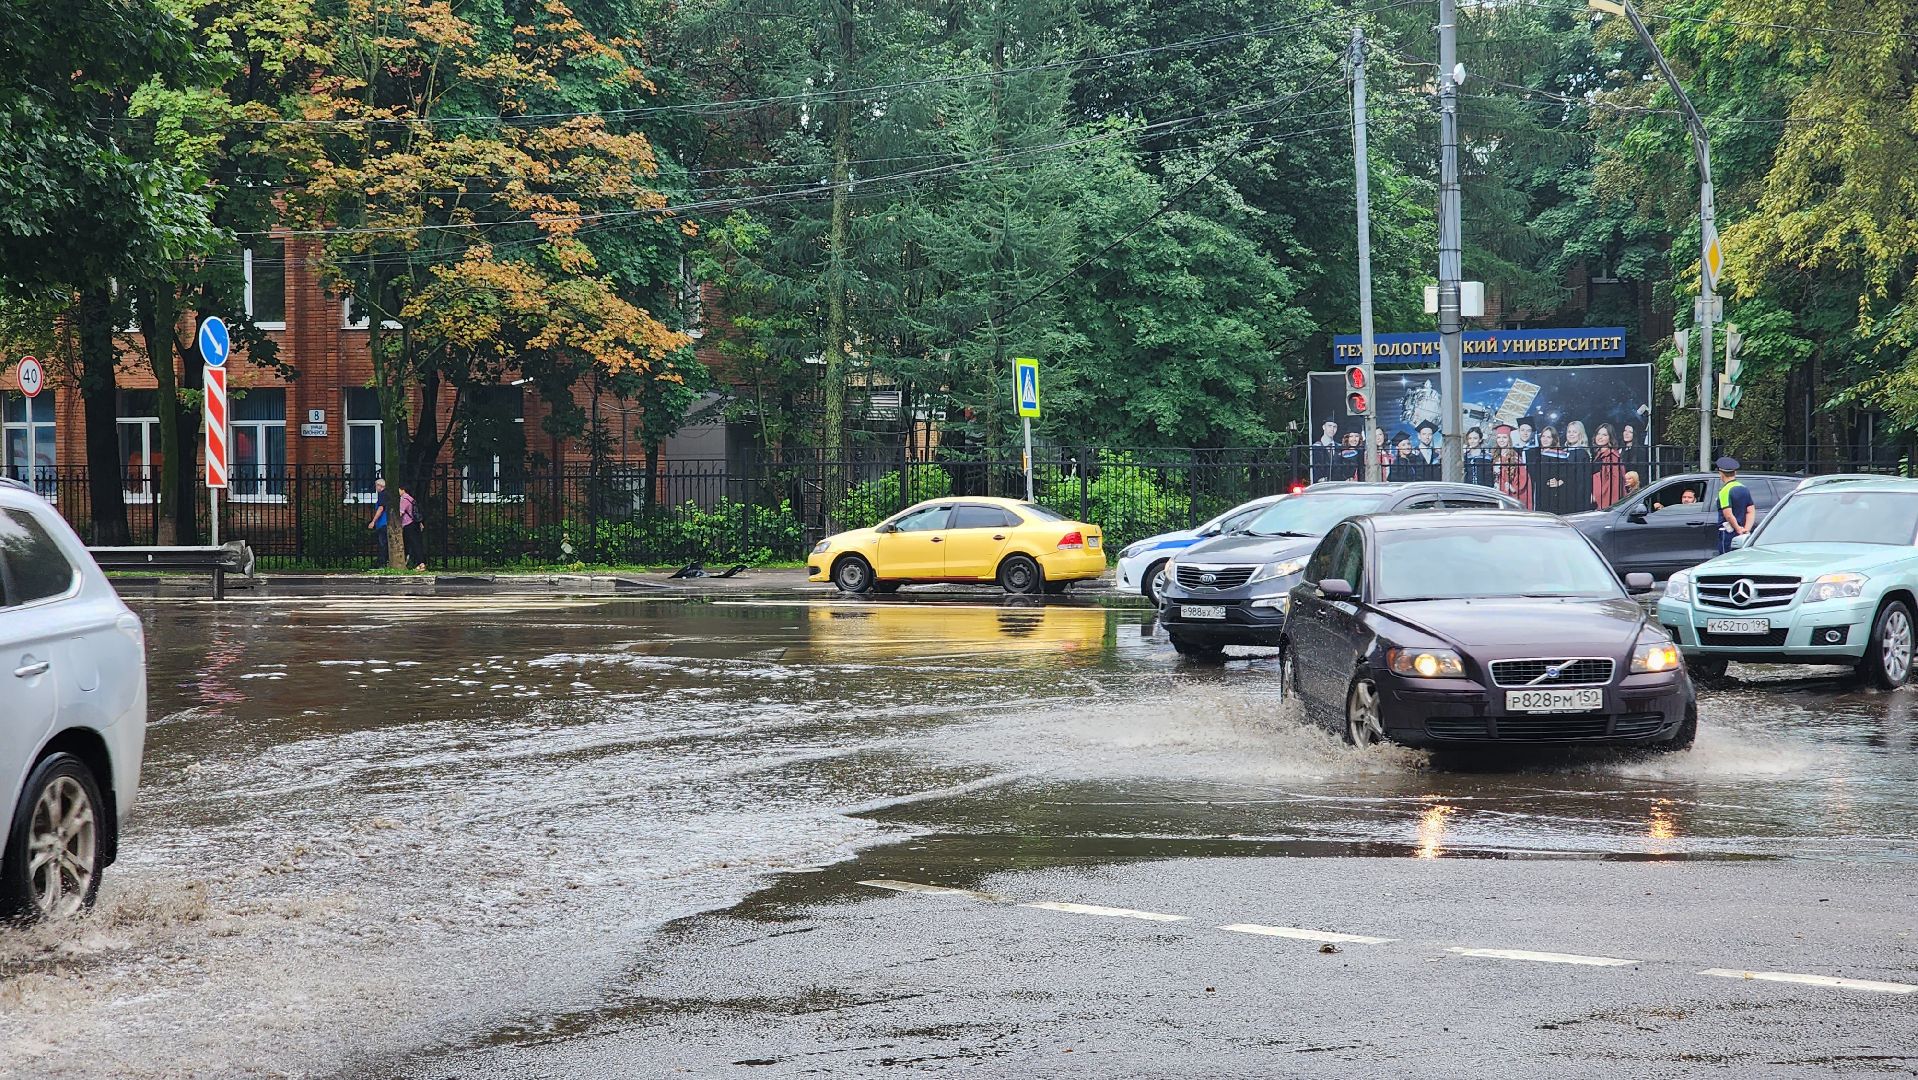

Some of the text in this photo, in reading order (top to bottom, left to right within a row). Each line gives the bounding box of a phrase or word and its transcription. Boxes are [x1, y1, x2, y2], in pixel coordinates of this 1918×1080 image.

[1336, 337, 1622, 357] ТЕХОЛОГИЧКИЙ УНИВЕРСИТЕТ
[23, 368, 37, 383] 40
[314, 411, 319, 420] 8
[1711, 620, 1767, 631] К452ТО 199
[1512, 691, 1599, 708] Р828РМ 150
